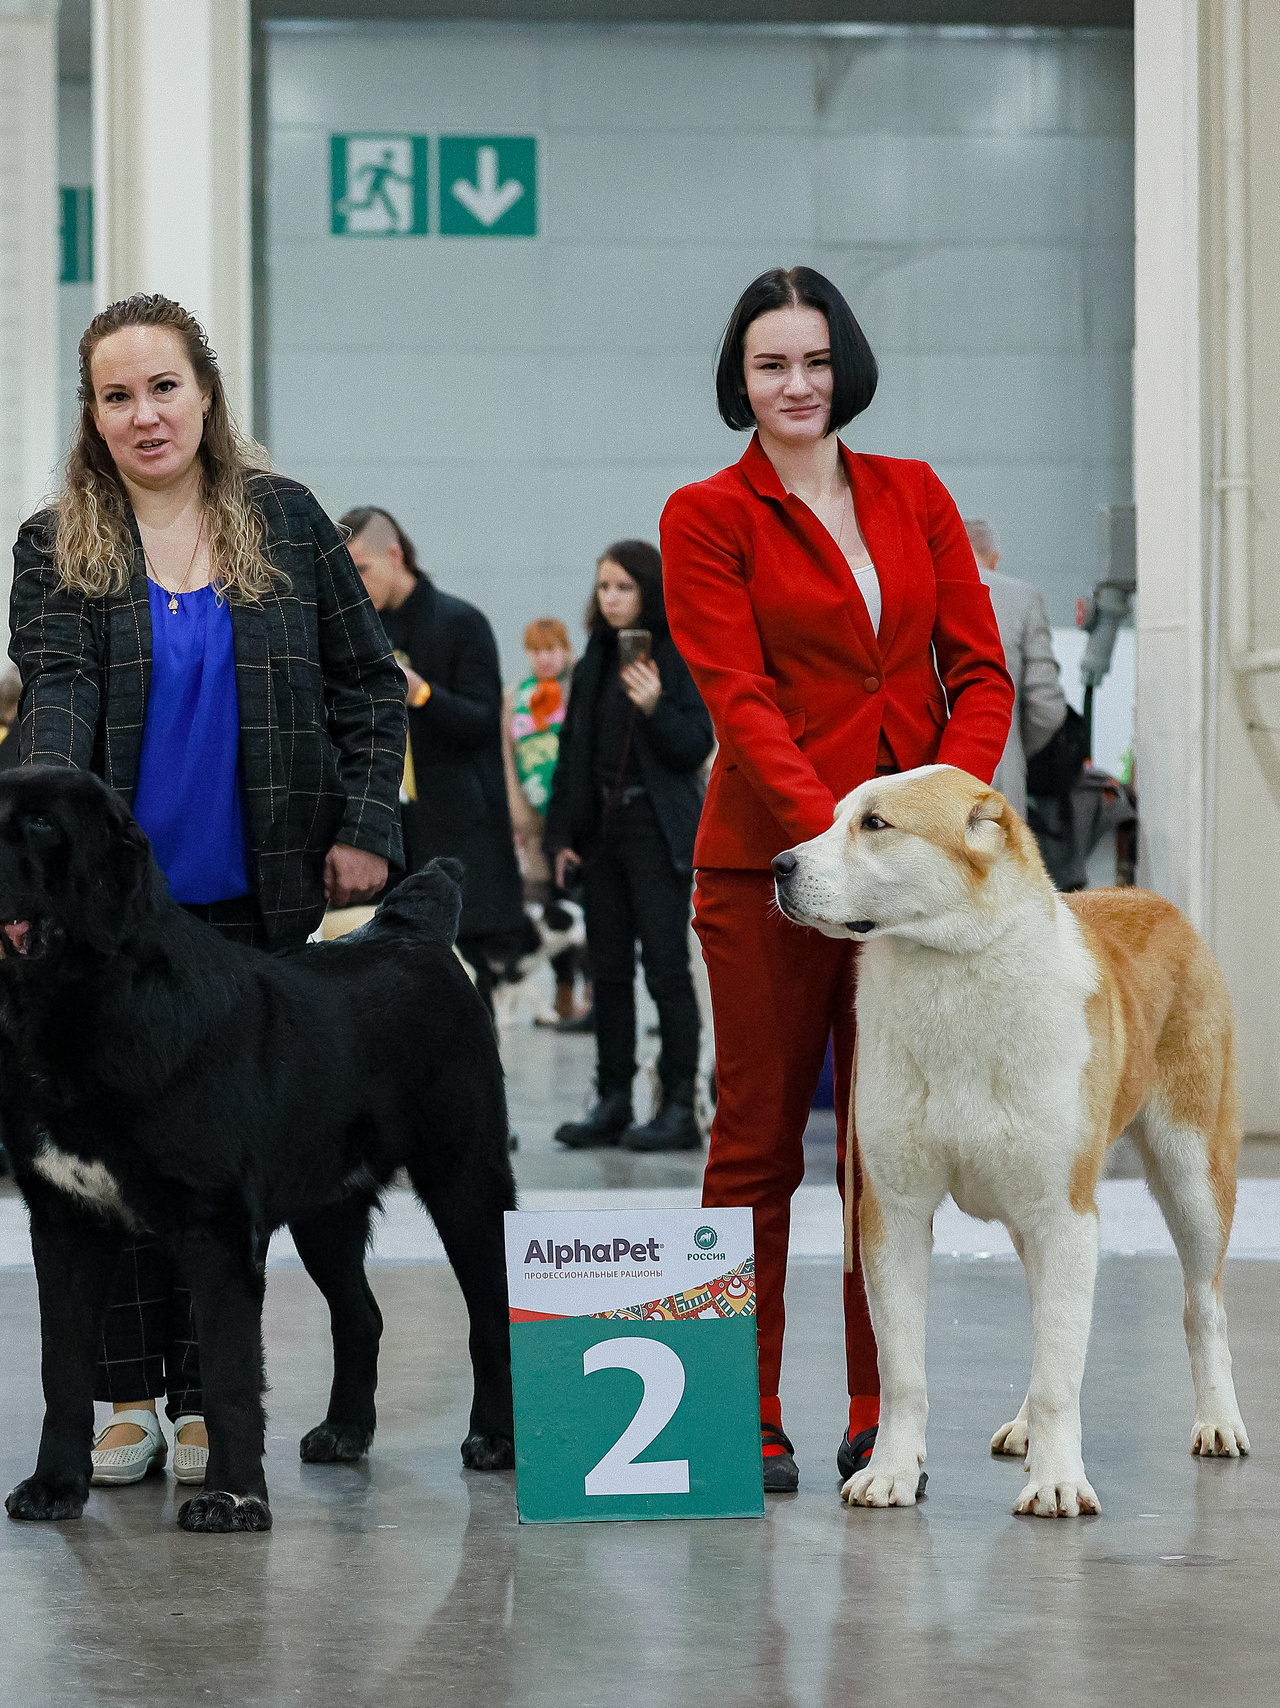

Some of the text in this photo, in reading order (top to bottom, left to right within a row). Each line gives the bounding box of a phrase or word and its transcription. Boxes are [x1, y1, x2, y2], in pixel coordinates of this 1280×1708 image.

[524, 1238, 660, 1269] AlphaPet
[687, 1252, 726, 1261] РОССИЯ
[524, 1269, 663, 1280] ПРОФЕССИОНАЛЬНЫЕ РАЦИОНЫ
[583, 1336, 690, 1496] 2
